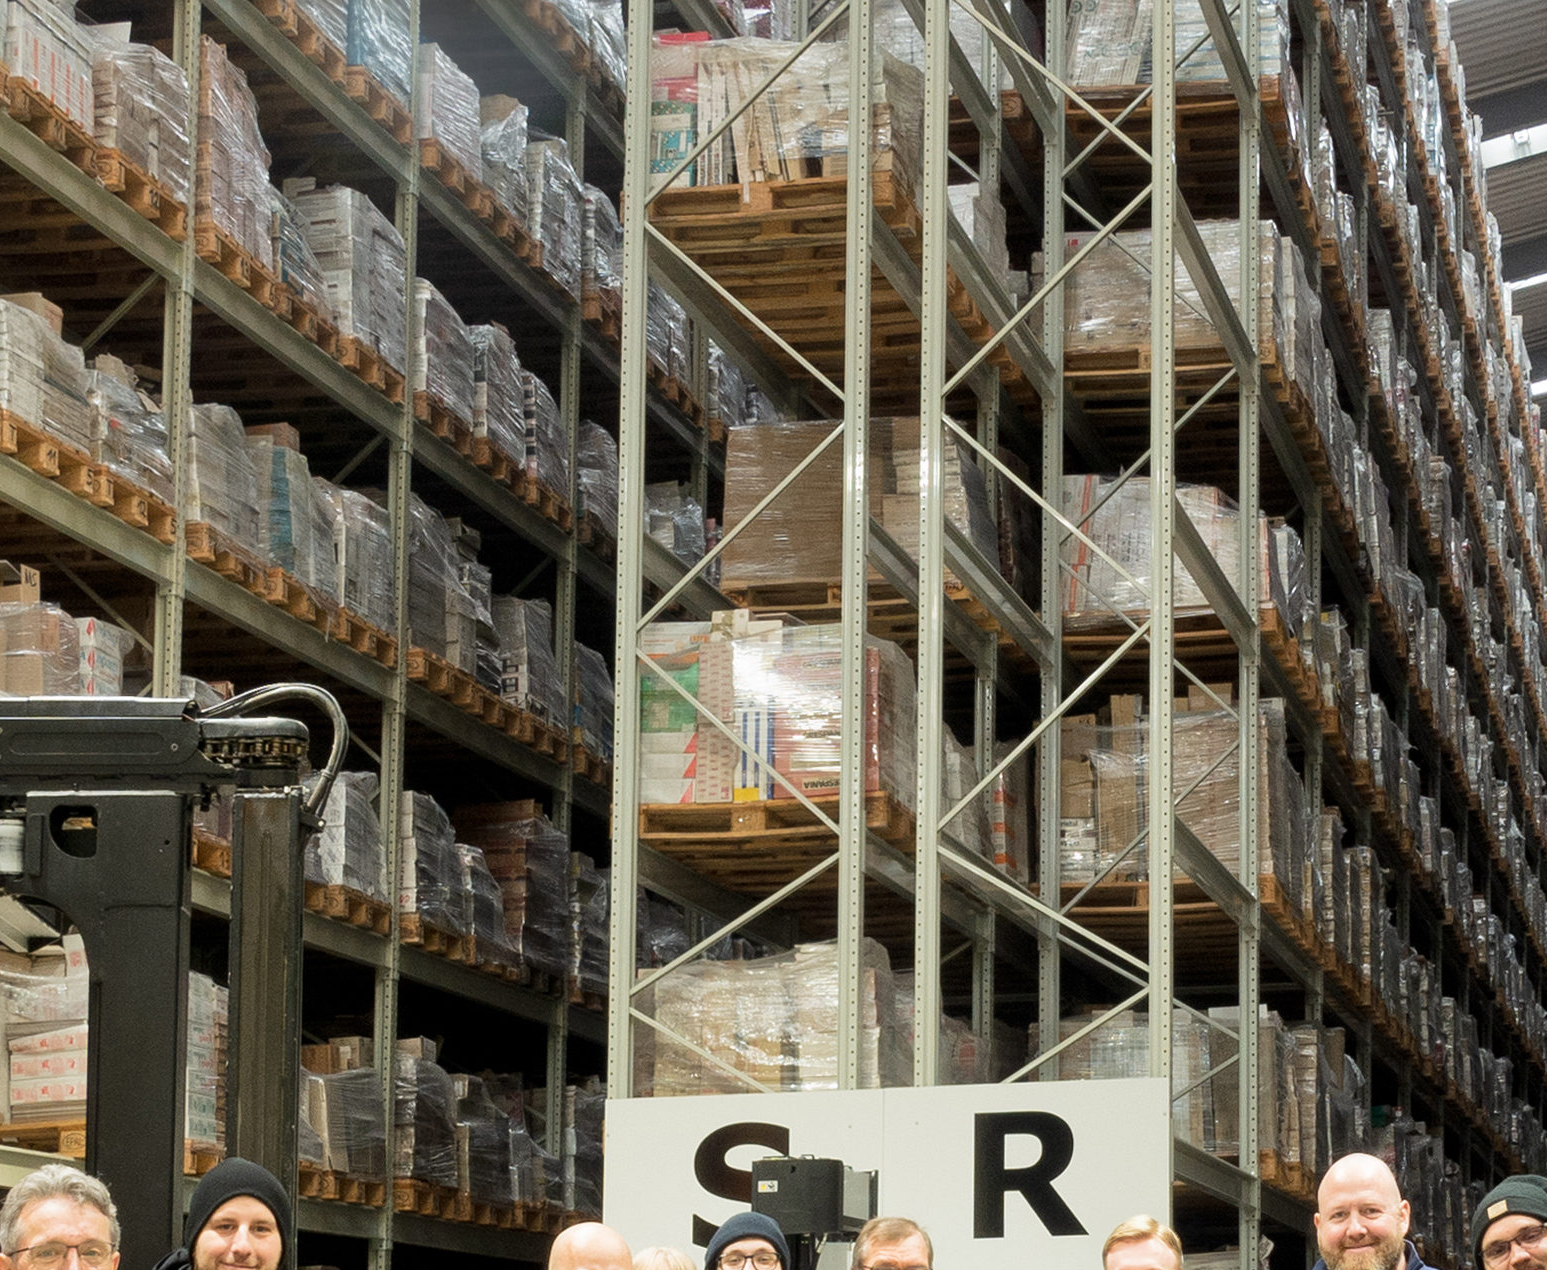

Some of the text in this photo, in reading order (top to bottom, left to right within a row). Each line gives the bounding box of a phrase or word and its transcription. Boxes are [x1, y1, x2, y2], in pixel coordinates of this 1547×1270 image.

[9, 423, 18, 441] T
[803, 777, 842, 791] ESPANIA
[693, 1122, 789, 1249] S
[974, 1111, 1090, 1239] R
